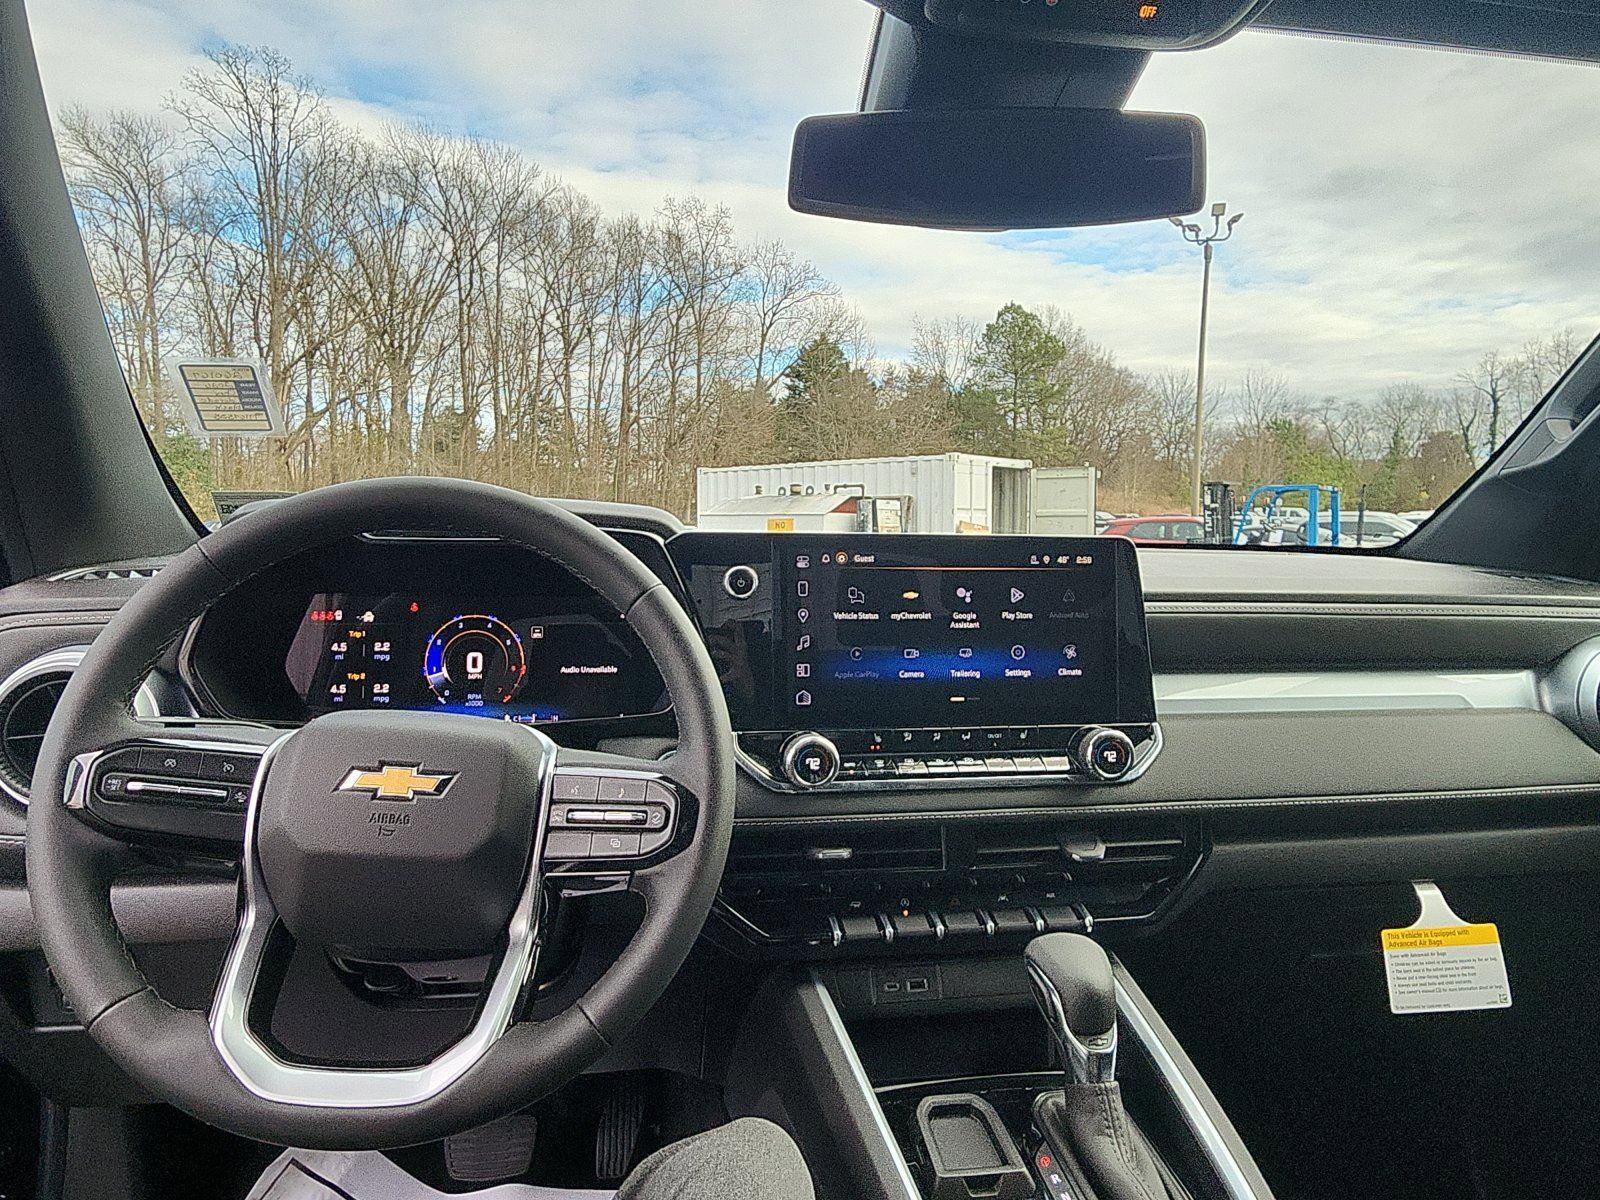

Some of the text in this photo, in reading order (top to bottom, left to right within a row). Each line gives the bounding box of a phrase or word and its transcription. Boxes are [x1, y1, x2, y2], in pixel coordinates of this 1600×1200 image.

[1139, 5, 1158, 19] OFF
[854, 554, 875, 563] Guest
[833, 611, 880, 620] Vehicle Status
[890, 611, 932, 621] myChevrolet
[952, 611, 977, 621] Google
[1001, 611, 1034, 621] Play Store
[950, 621, 980, 629] Assistant
[348, 630, 362, 639] Trip
[330, 642, 348, 652] 4.5
[373, 642, 391, 652] 2.2
[466, 651, 484, 674] 0
[560, 665, 618, 674] Audio Unavailable
[899, 670, 925, 679] Camera
[950, 669, 981, 679] Trailering
[1004, 669, 1032, 678] Settings
[1057, 668, 1083, 676] Climate
[347, 672, 360, 681] Trip
[834, 671, 880, 679] Apple CarPlay
[329, 684, 347, 694] 4.5
[373, 683, 390, 693] 2.2
[373, 695, 390, 703] mpg
[1103, 751, 1117, 763] 72
[805, 757, 821, 771] 72
[368, 812, 411, 825] AIRBAG
[1387, 932, 1400, 940] This
[1401, 931, 1423, 939] Vehicle
[1429, 929, 1456, 939] Equipped
[1388, 939, 1418, 948] Advanced
[1428, 939, 1443, 947] Bags
[1050, 1173, 1062, 1185] R
